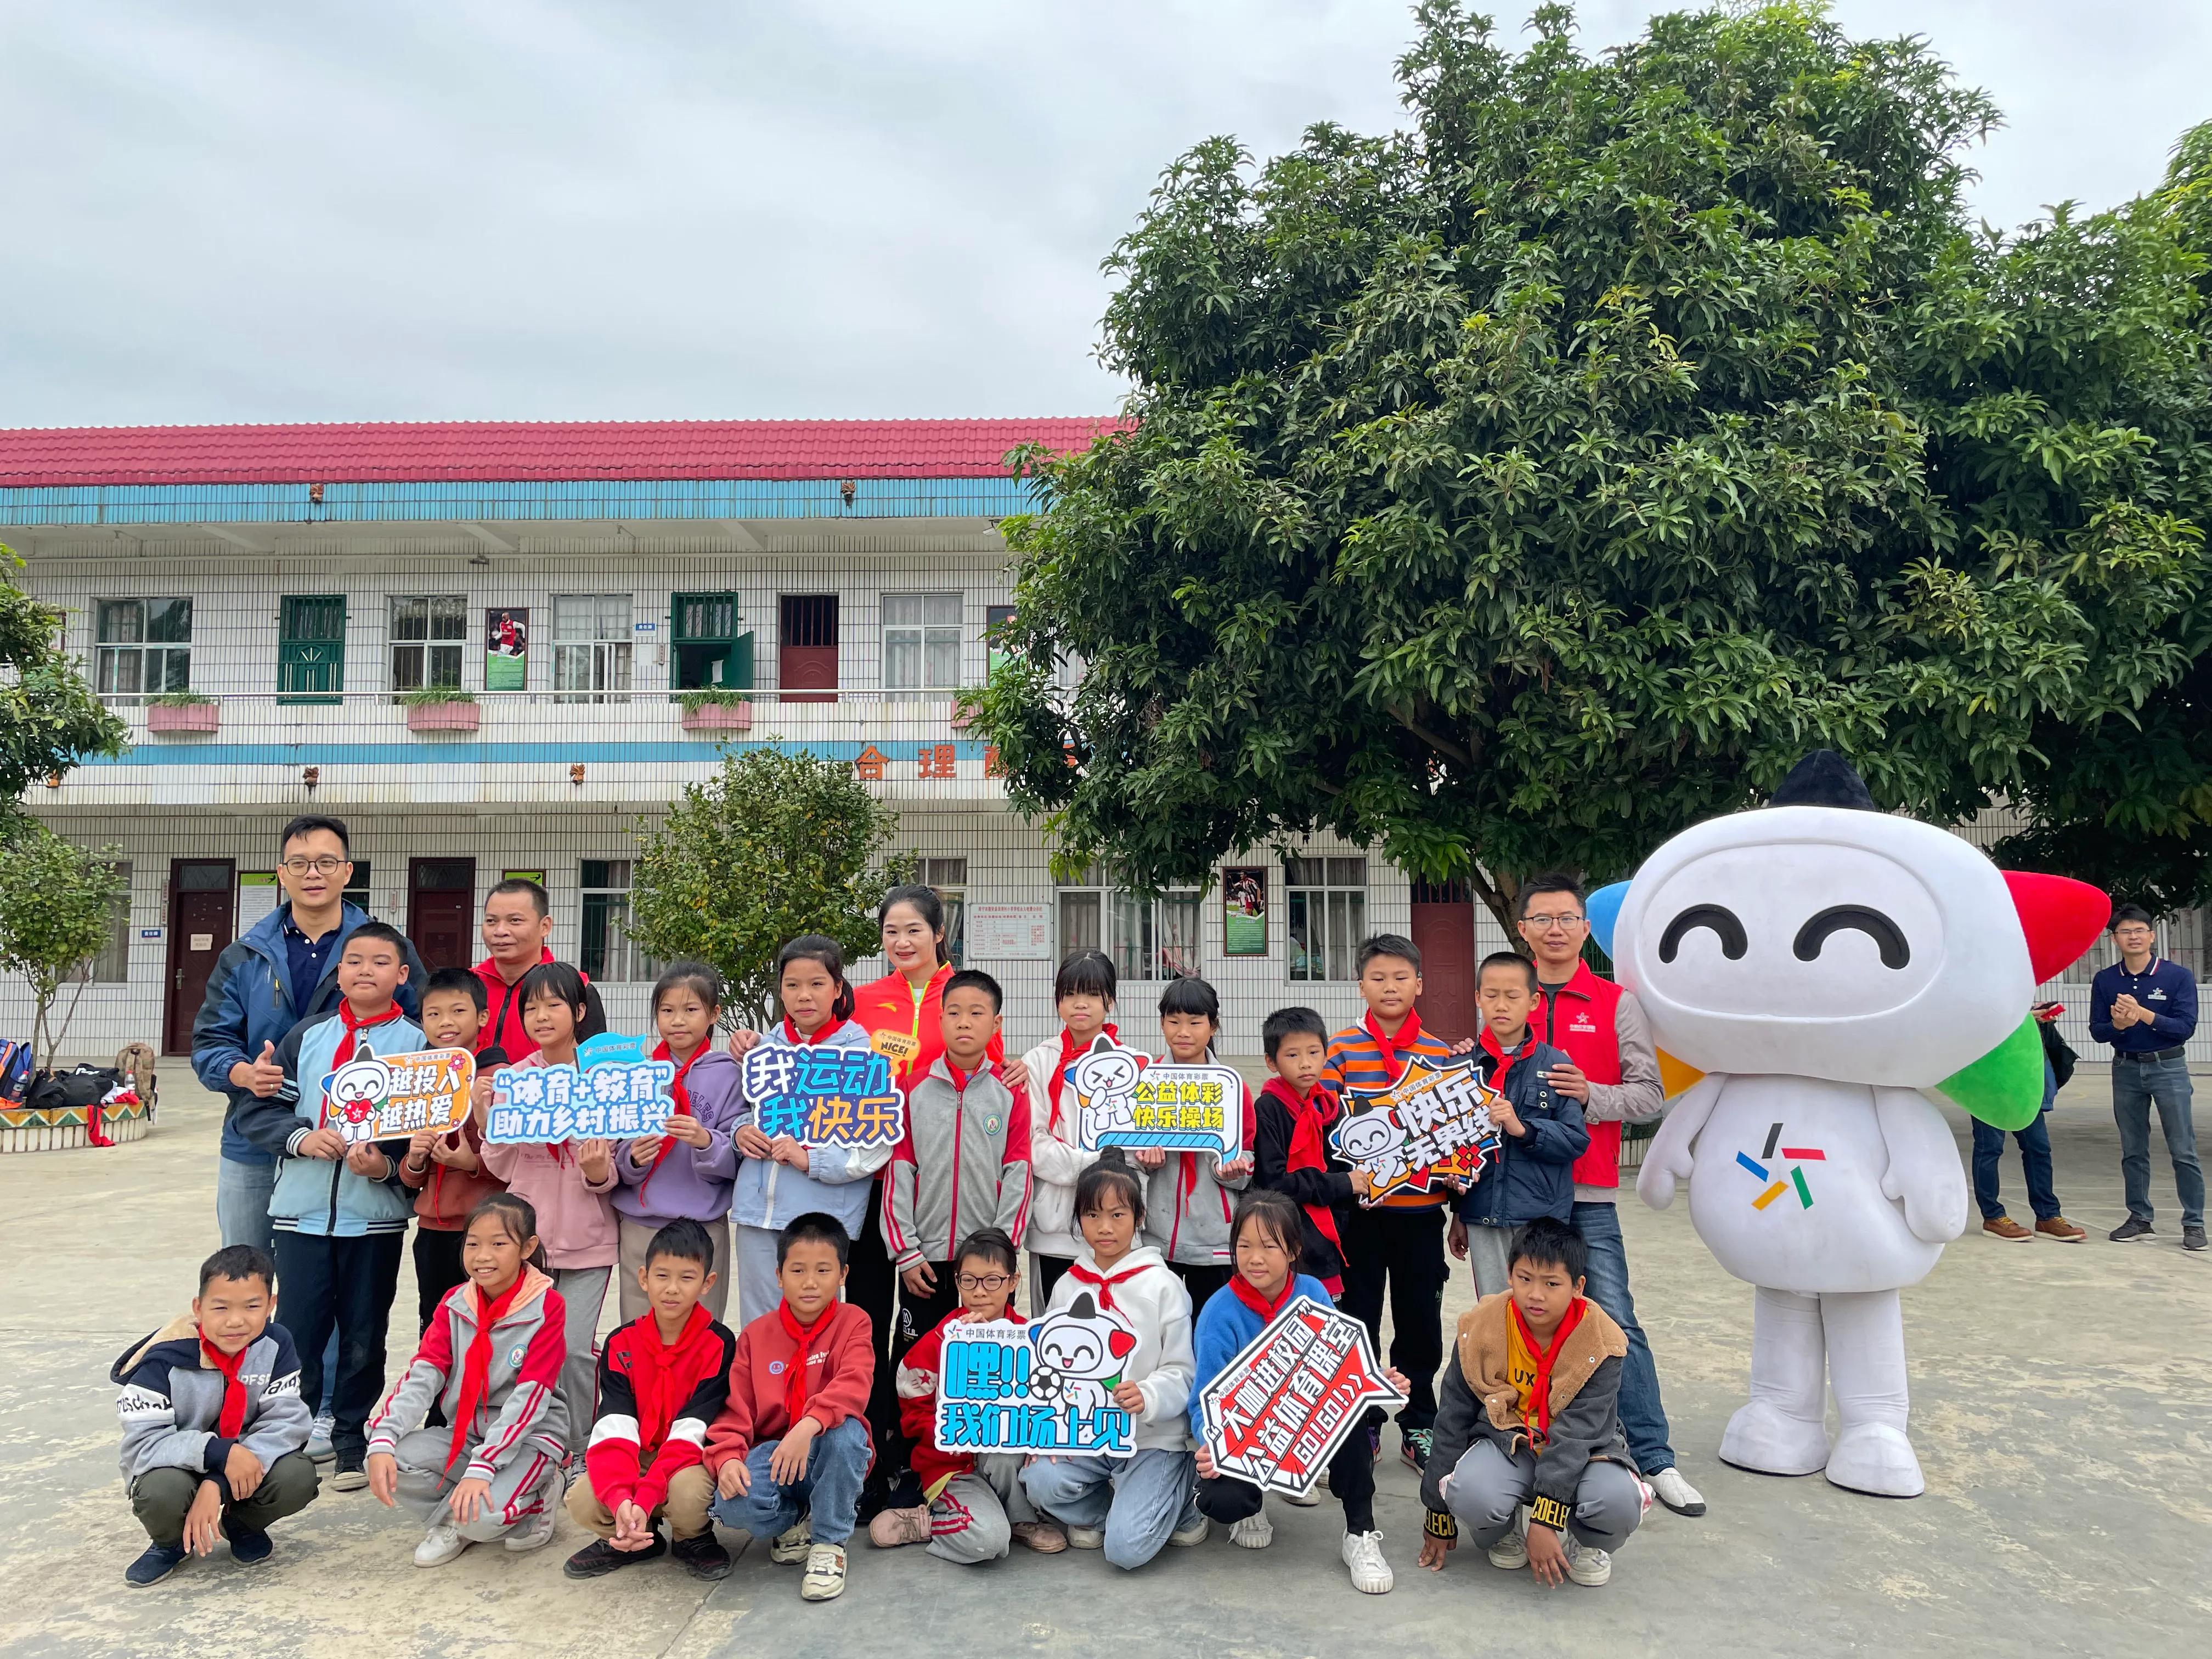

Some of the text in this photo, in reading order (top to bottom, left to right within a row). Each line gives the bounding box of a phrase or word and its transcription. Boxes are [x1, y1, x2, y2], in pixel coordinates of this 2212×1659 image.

[415, 1053, 450, 1062] 中国体育彩票
[596, 1042, 635, 1053] 中国体育彩票
[881, 1043, 909, 1057] NICE!
[388, 1064, 461, 1098] 越投入
[751, 1051, 889, 1096] 我运动
[1163, 1073, 1209, 1081] 中国体育彩票
[1402, 1071, 1442, 1095] 中国体育彩票
[1136, 1081, 1224, 1105] 公益体彩
[1398, 1068, 1485, 1136] 快乐
[378, 1092, 453, 1134] 越热爱
[494, 1104, 667, 1136] 助力乡村振兴
[762, 1096, 896, 1141] 我快乐
[1133, 1105, 1224, 1131] 快乐操场
[1406, 1105, 1499, 1172] 无界线
[966, 1328, 1026, 1340] 中国体育彩票
[1219, 1365, 1251, 1397] 中国体育彩票
[1240, 1314, 1361, 1486] 公益体育课堂
[941, 1402, 1132, 1451] 我们场上见
